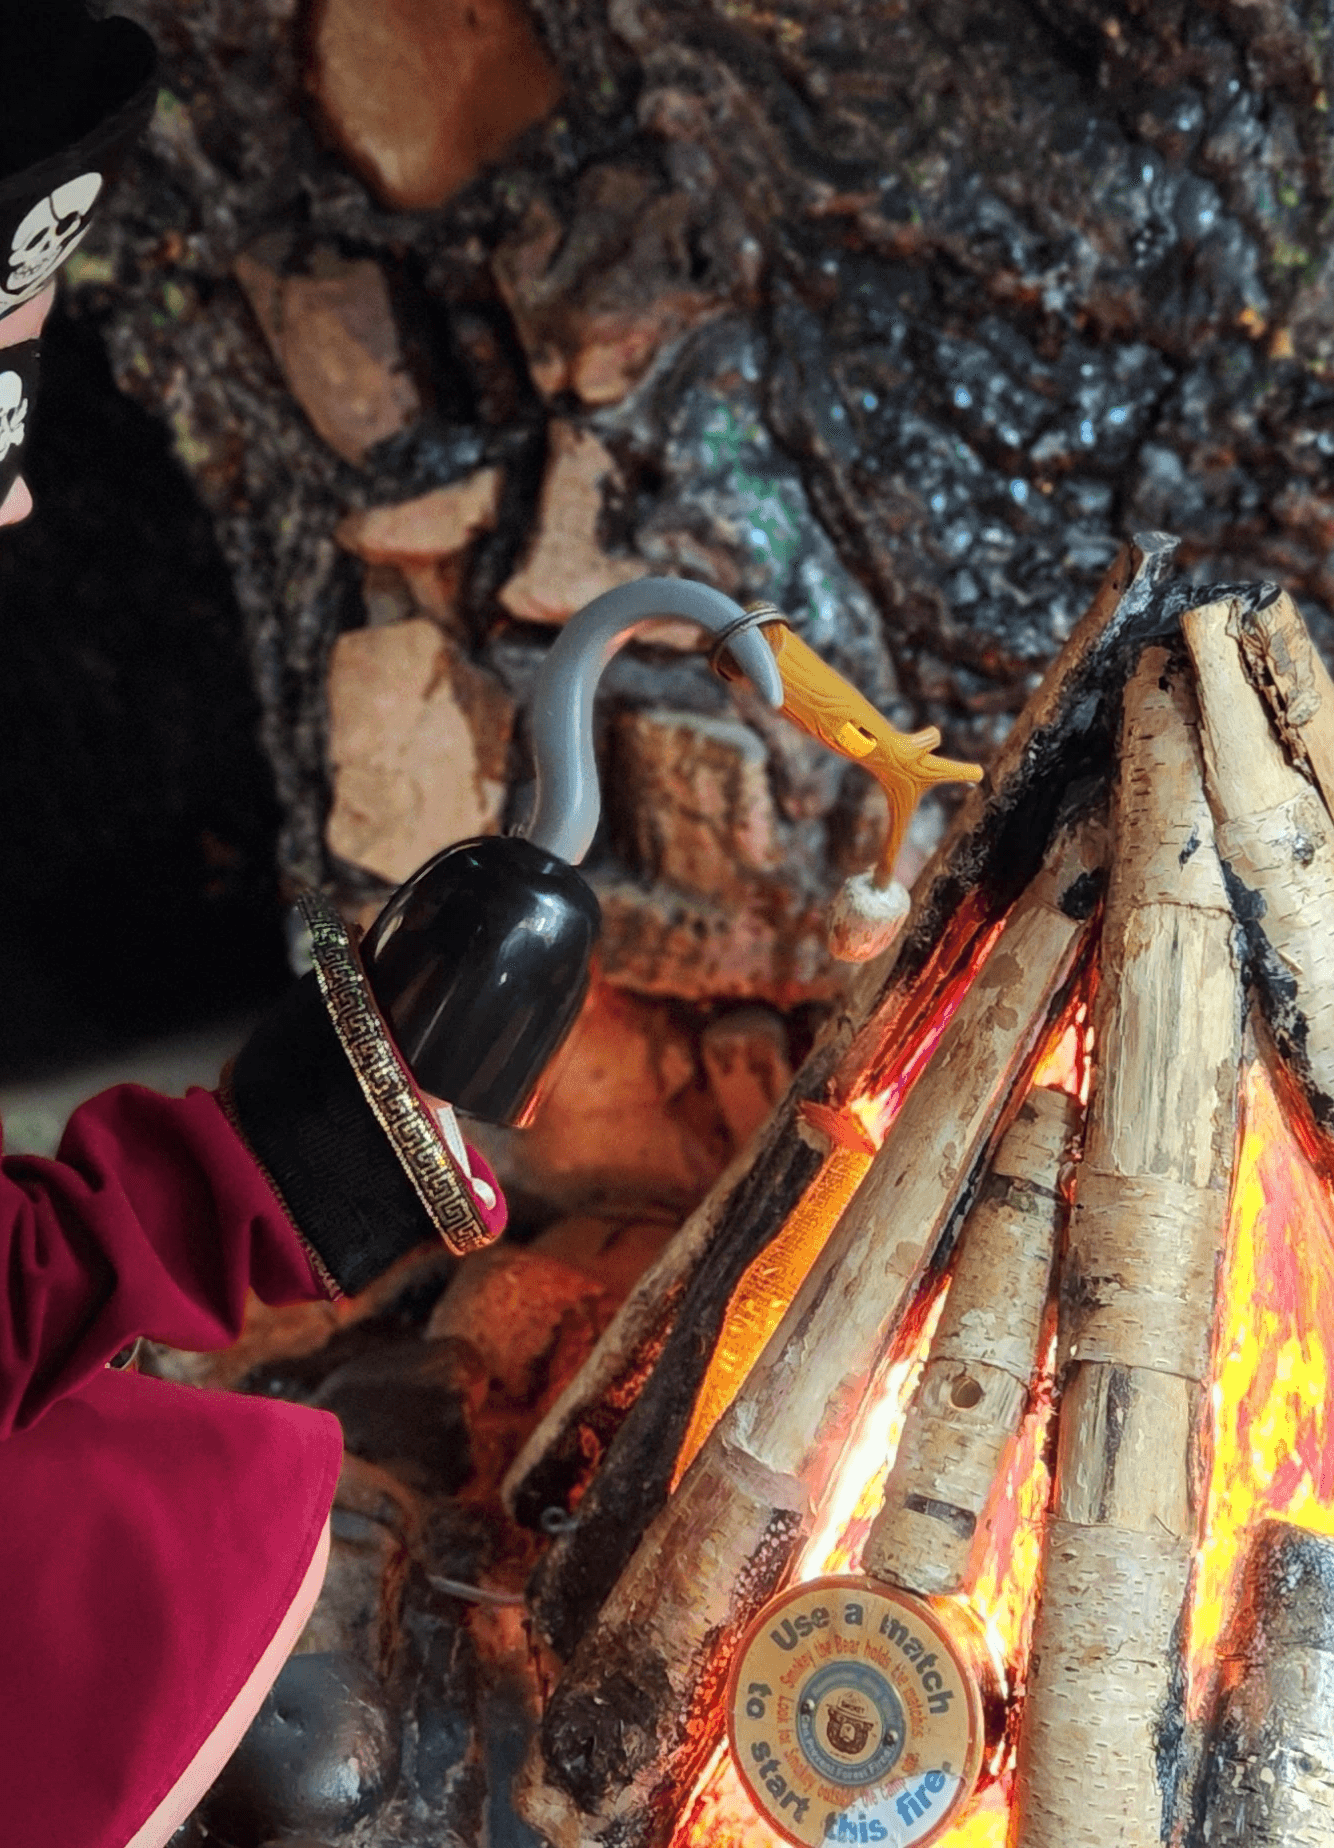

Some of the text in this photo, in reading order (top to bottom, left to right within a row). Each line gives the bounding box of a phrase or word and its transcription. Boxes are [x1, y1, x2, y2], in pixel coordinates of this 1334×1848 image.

[770, 1606, 830, 1651] Use
[844, 1603, 864, 1626] a
[779, 1650, 816, 1689] Smokey
[814, 1639, 832, 1658] the
[834, 1634, 860, 1654] Bear
[863, 1639, 892, 1669] holds
[890, 1661, 909, 1686] the
[879, 1613, 955, 1715] match
[745, 1682, 772, 1719] to
[777, 1695, 795, 1724] Look
[750, 1741, 810, 1824] start
[824, 1811, 888, 1843] this
